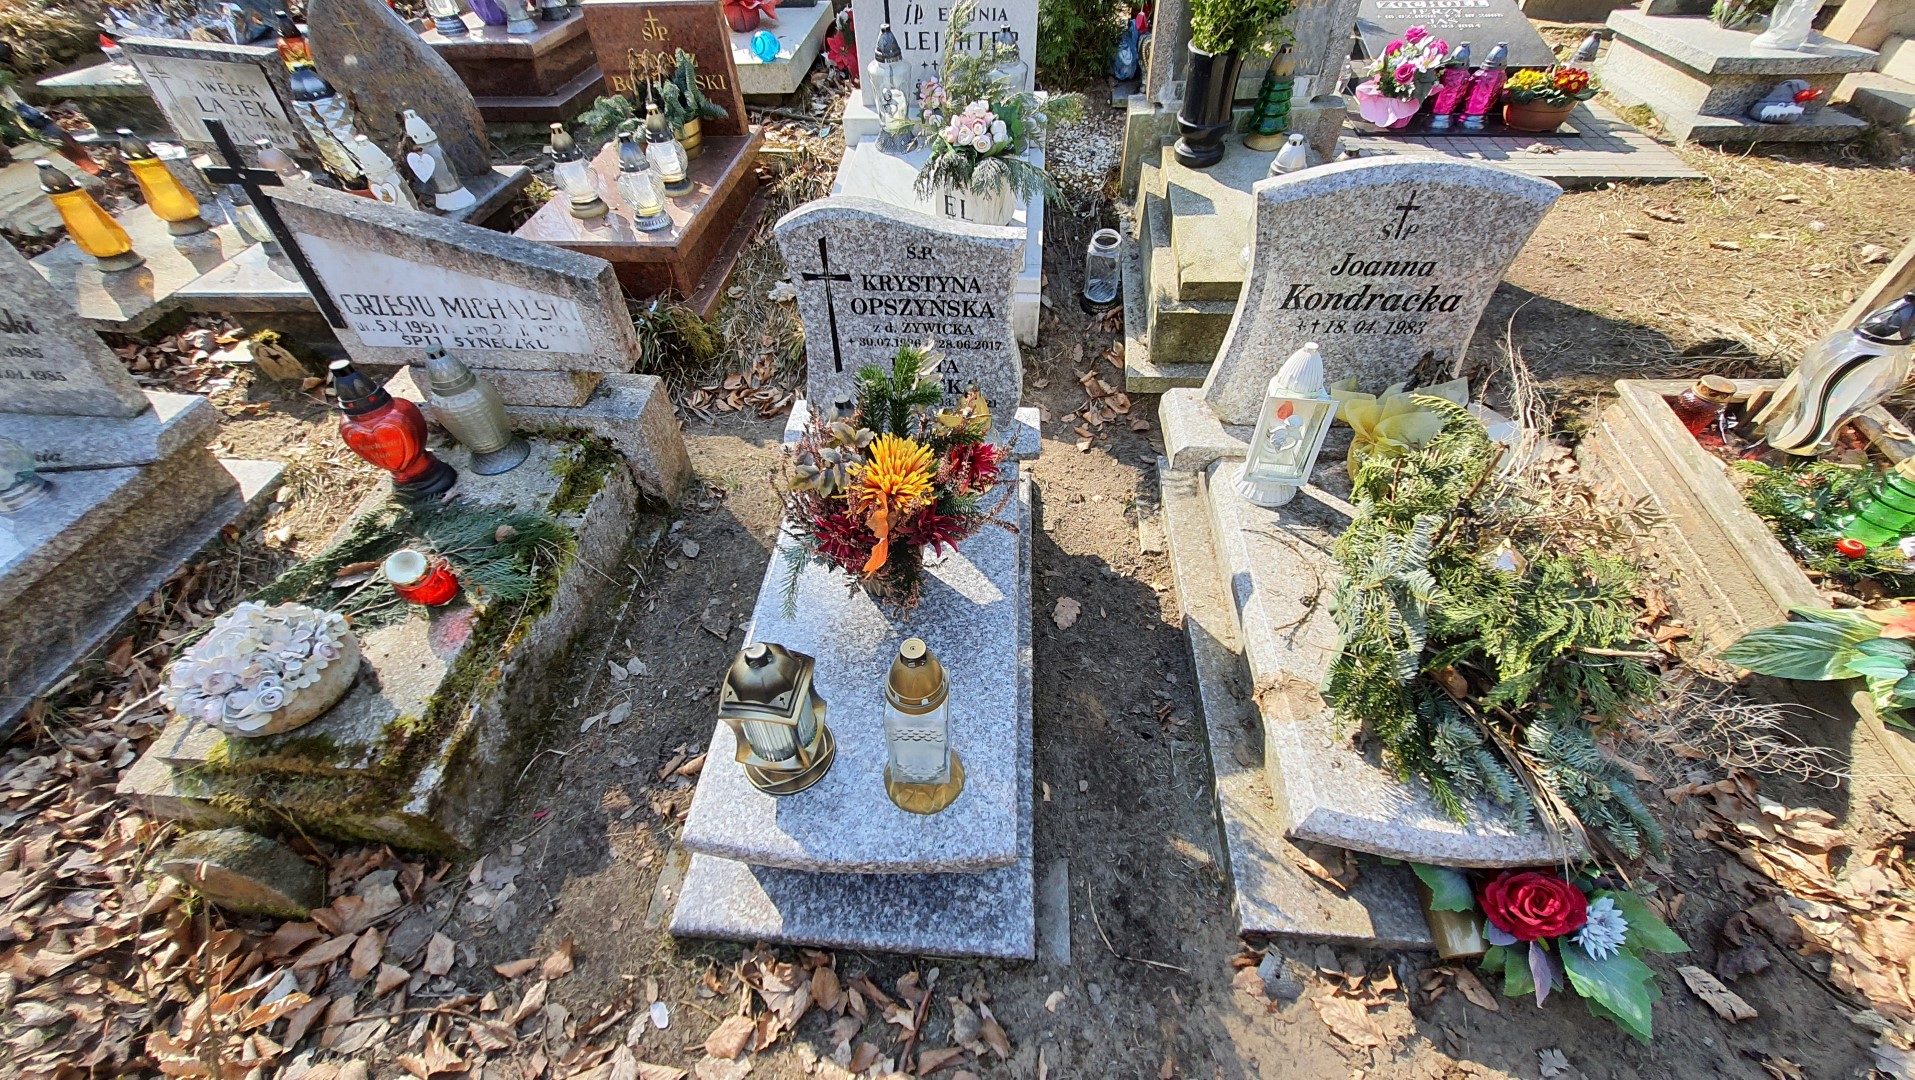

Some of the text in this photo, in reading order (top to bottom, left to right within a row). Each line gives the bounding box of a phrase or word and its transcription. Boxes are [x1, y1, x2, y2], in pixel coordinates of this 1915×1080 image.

[1330, 252, 1438, 277] Joanna
[861, 274, 982, 294] KRYSTYNA
[340, 293, 436, 318] GRZESIU
[850, 295, 996, 319] OPSZYŃSKA
[1278, 284, 1463, 313] Kondracka
[1323, 319, 1428, 335] 18. 04. 1983
[938, 339, 1002, 351] 28.06.2017
